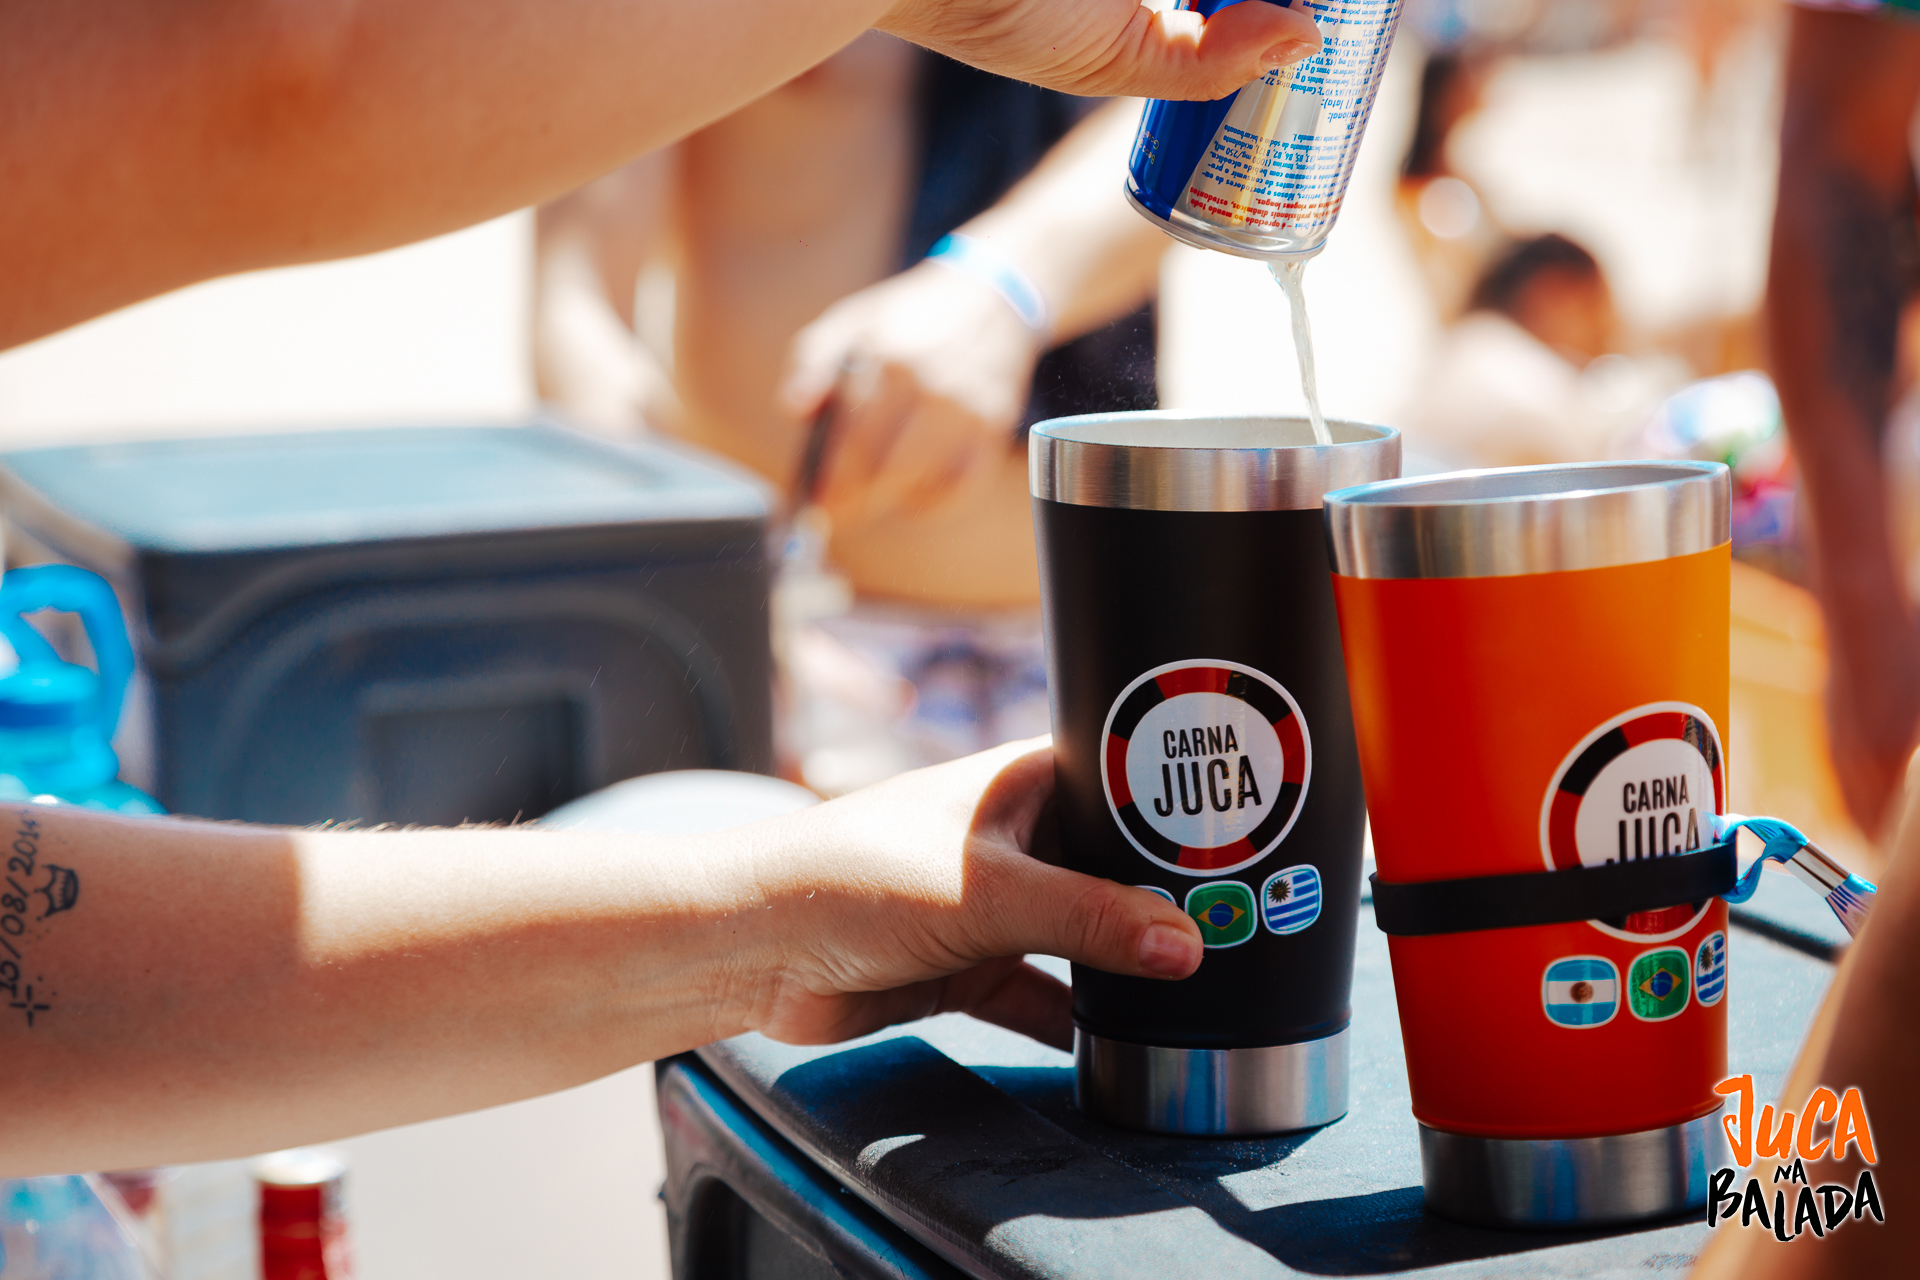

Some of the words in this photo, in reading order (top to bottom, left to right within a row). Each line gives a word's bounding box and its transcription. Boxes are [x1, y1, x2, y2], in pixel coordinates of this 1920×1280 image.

[1302, 1, 1329, 12] maiores
[1313, 14, 1322, 23] de
[1323, 16, 1339, 26] dieta
[1265, 77, 1275, 86] 27
[1276, 80, 1317, 96] Carboidratos
[1224, 125, 1258, 143] bicarbonato
[1223, 135, 1254, 151] acidulante
[1281, 142, 1289, 151] de
[1209, 151, 1242, 169] alcoólica.
[1225, 148, 1252, 161] mg/250
[1272, 149, 1283, 159] B2,
[1208, 162, 1224, 172] pro-
[1243, 164, 1268, 177] bebida
[1215, 176, 1224, 184] de
[1230, 171, 1264, 184] consumir
[1269, 170, 1283, 178] com
[1225, 179, 1266, 195] portadores
[1264, 180, 1274, 188] de
[1189, 187, 1228, 207] estudantes
[1190, 198, 1207, 211] todo
[1230, 201, 1269, 218] dinâmicos,
[1255, 198, 1281, 210] longas.
[1208, 206, 1233, 218] mundo
[1270, 211, 1311, 220] profissionais
[1245, 217, 1281, 228] apreciado
[1162, 724, 1239, 760] CARNA
[1153, 755, 1263, 818] JUCA
[1622, 774, 1690, 814] CARNA
